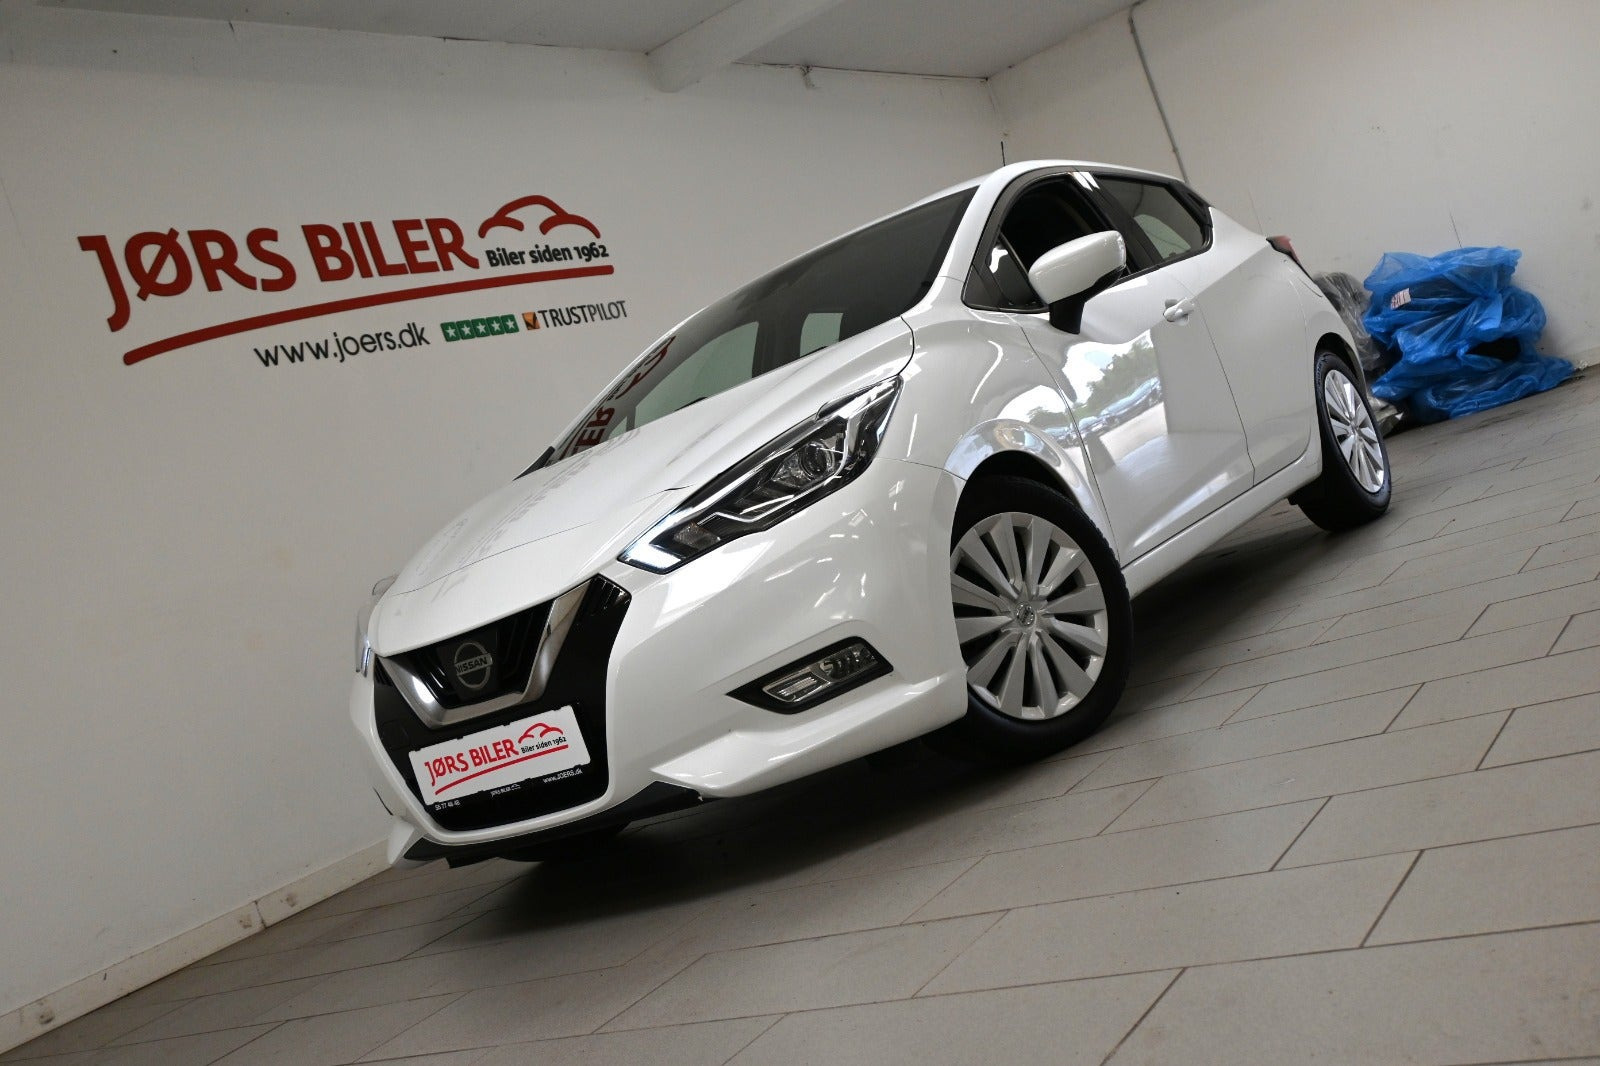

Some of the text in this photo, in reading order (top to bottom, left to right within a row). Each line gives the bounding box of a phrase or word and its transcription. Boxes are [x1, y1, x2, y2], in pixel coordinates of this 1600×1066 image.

[485, 242, 609, 268] Biler siden 1962
[78, 217, 480, 332] JØRS BILER
[538, 300, 627, 328] TRUSTPILOT
[253, 322, 430, 368] www.joers.dk
[455, 656, 488, 673] NISSAN
[520, 736, 567, 754] Biler siden 1962
[424, 738, 519, 787] JØRS BILER
